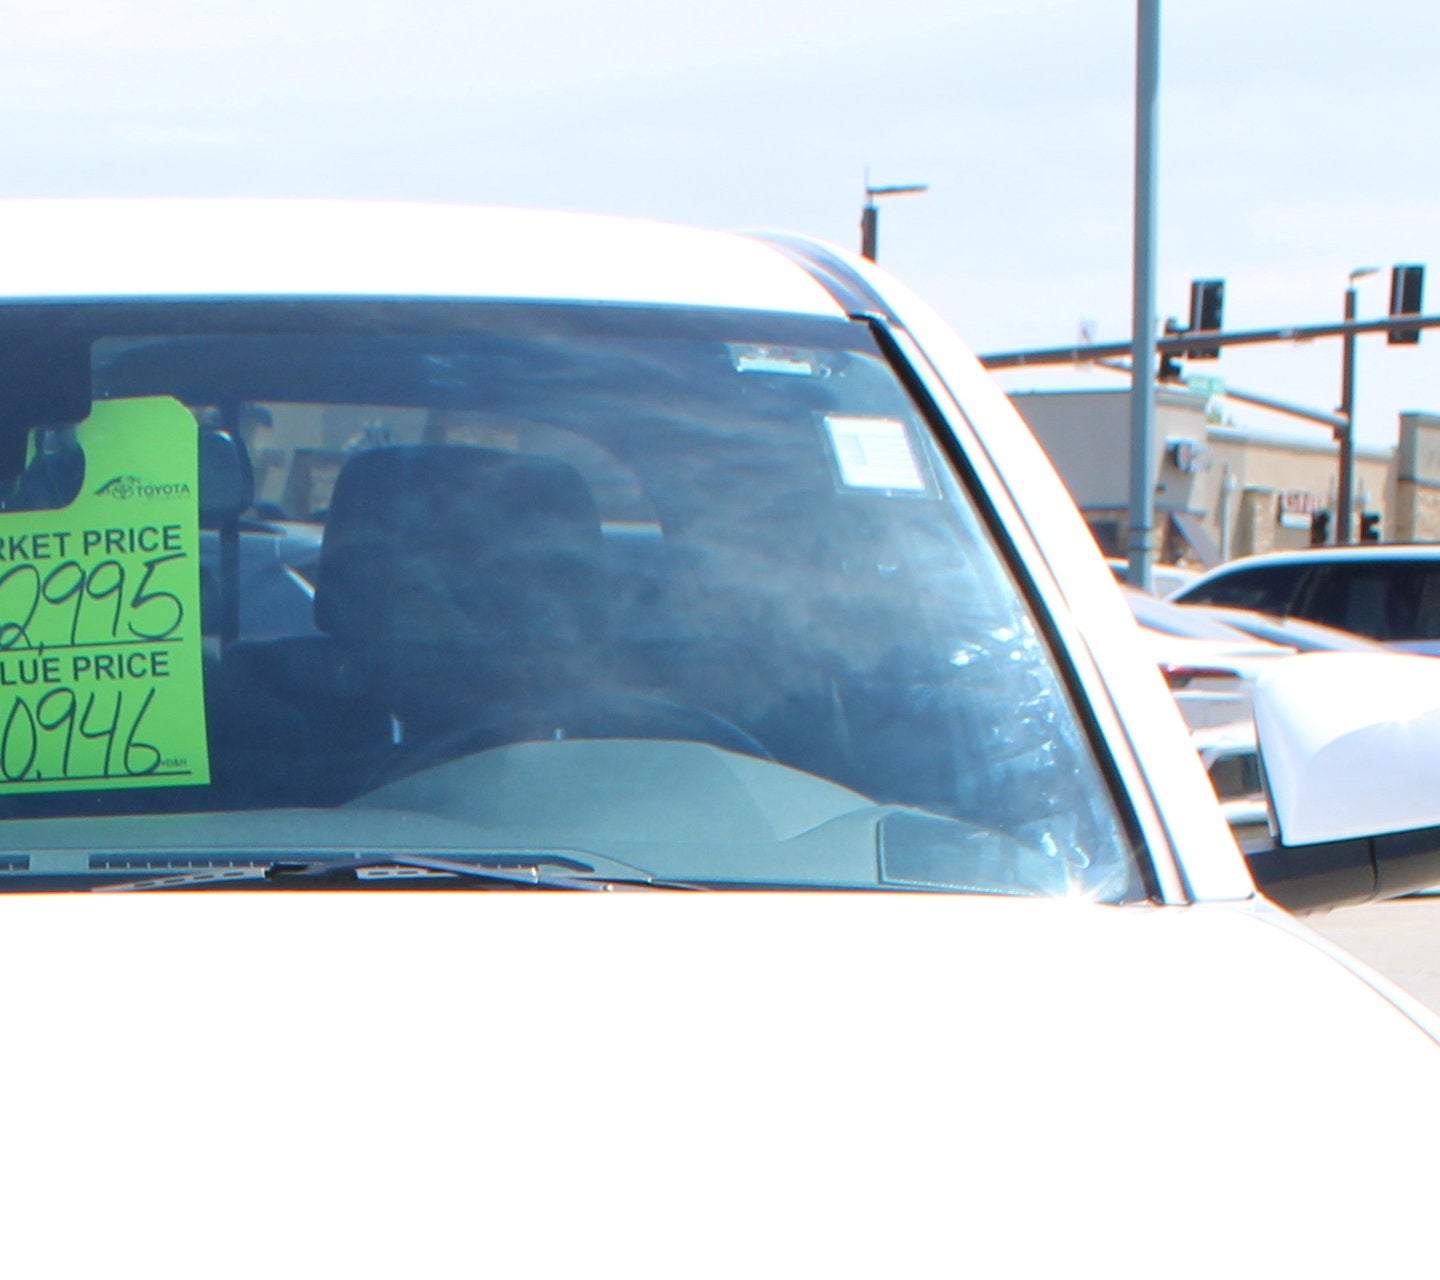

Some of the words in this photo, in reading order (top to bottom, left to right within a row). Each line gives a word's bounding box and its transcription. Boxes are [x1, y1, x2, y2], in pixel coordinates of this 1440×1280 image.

[137, 483, 191, 497] TOYOTA
[82, 524, 183, 556] PRICE
[72, 651, 170, 682] PRICE
